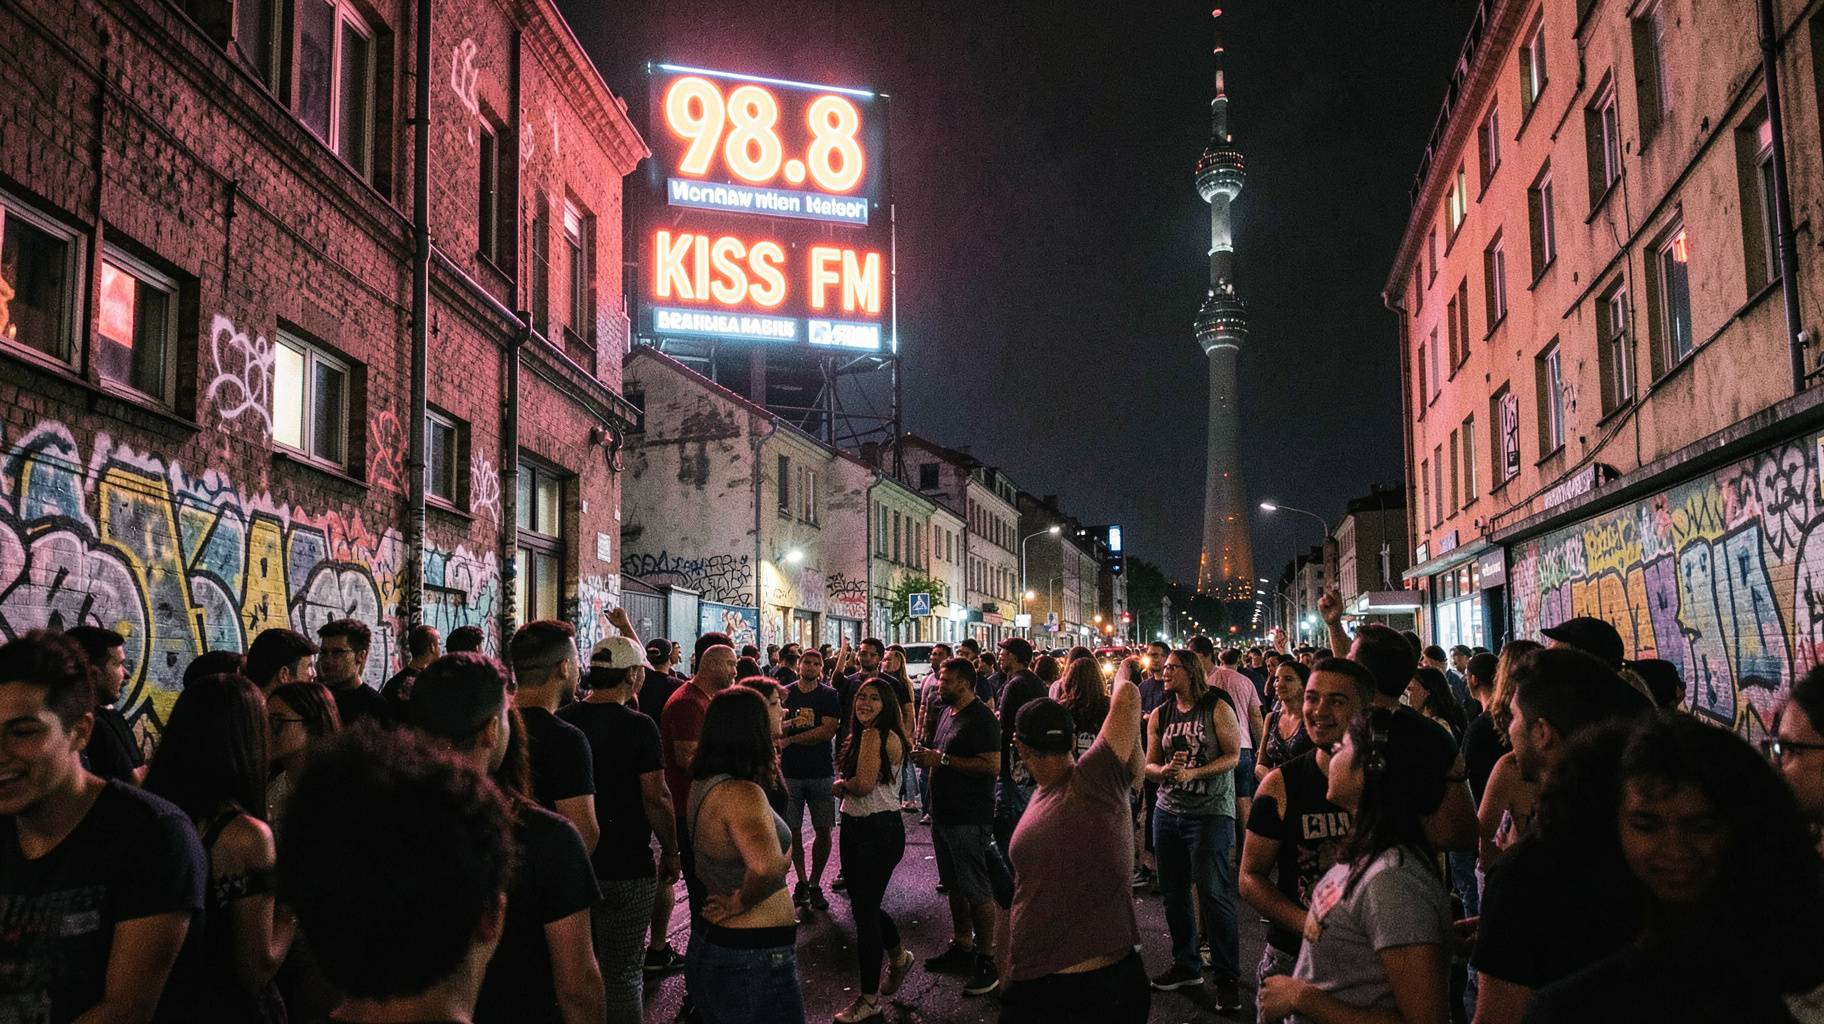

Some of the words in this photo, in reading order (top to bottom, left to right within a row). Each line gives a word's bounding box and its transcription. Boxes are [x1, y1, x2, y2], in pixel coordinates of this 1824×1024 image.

[667, 77, 863, 191] 98.8
[656, 231, 786, 307] KISS
[811, 247, 880, 313] FM
